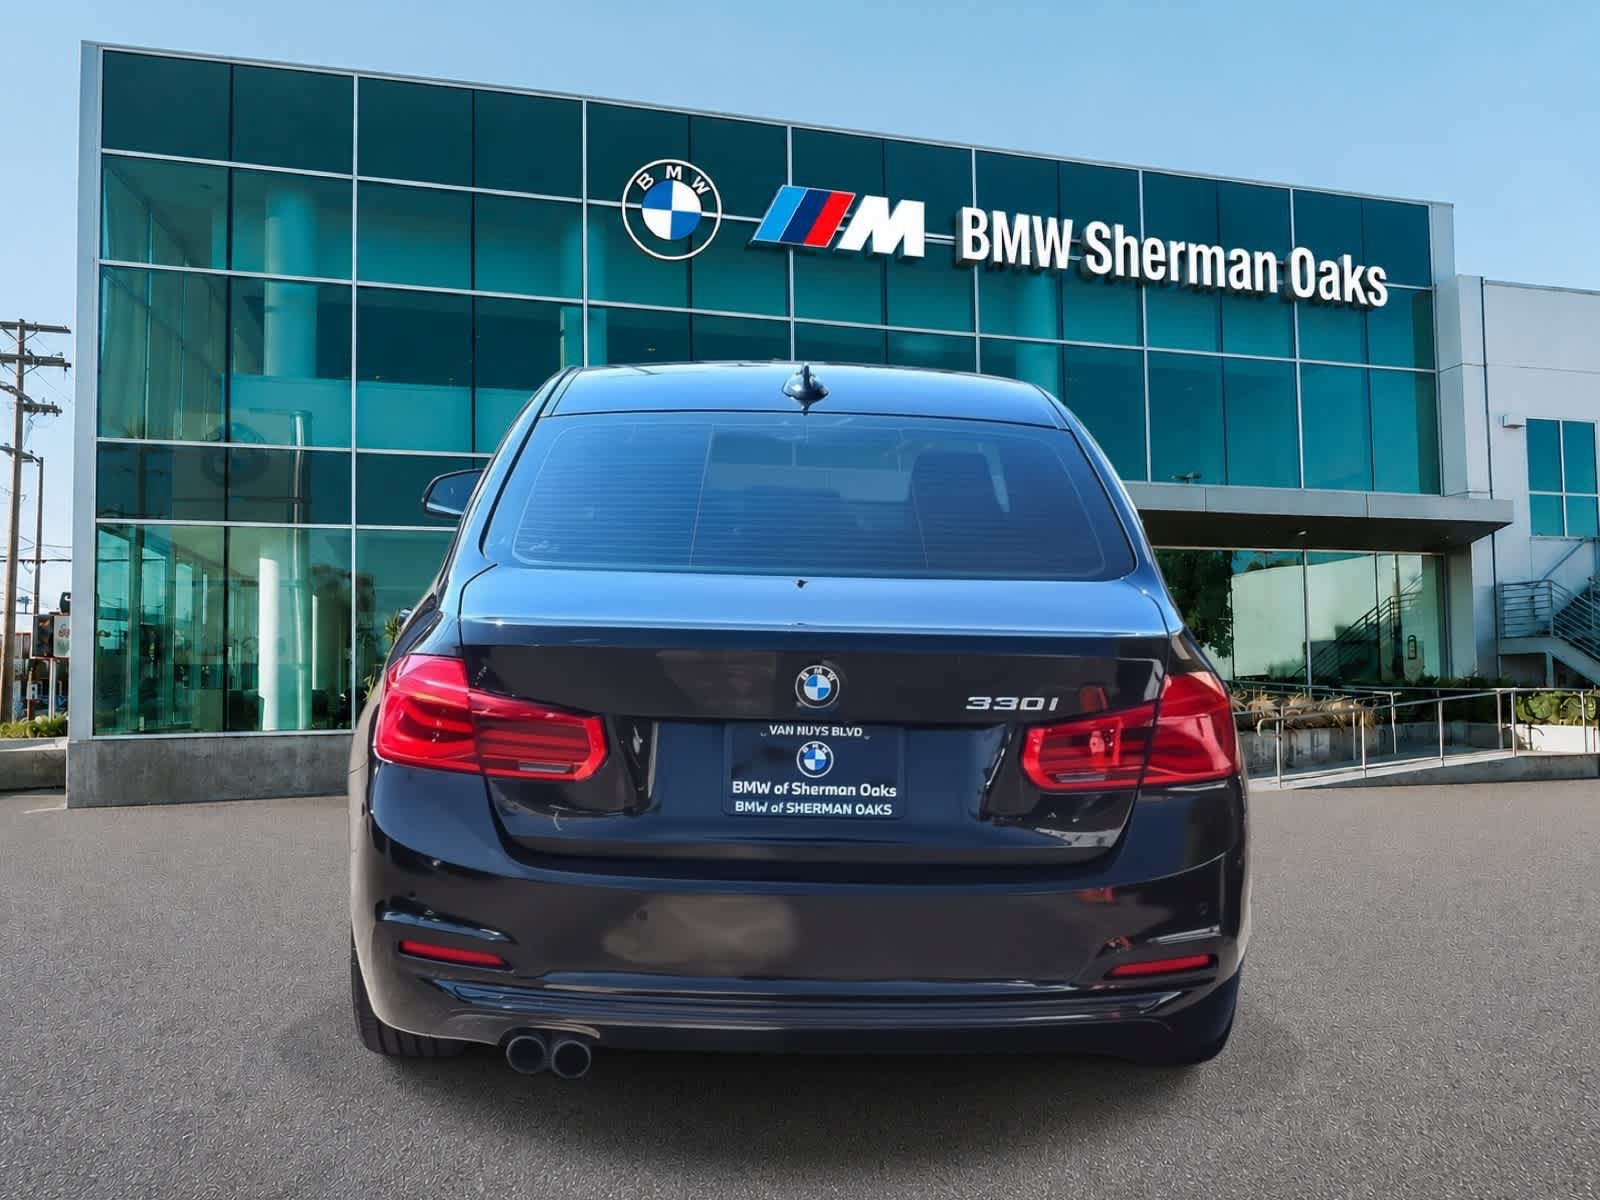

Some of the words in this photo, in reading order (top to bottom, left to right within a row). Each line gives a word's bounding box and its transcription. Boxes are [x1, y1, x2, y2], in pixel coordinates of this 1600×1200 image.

[636, 165, 711, 195] BMW
[962, 206, 1073, 269] BMW
[1085, 221, 1278, 294] Sherman
[1290, 247, 1389, 308] Oaks
[800, 667, 836, 681] BMW
[769, 725, 794, 736] VAN
[797, 726, 829, 737] NUYS
[831, 727, 863, 738] BLVD
[732, 781, 771, 795] BMW
[774, 782, 790, 795] of
[791, 783, 856, 797] Sherman
[860, 784, 897, 797] Oaks
[735, 801, 768, 814] BMW
[771, 802, 784, 813] of
[786, 803, 851, 815] SHERMAN
[855, 804, 893, 816] OAKS
